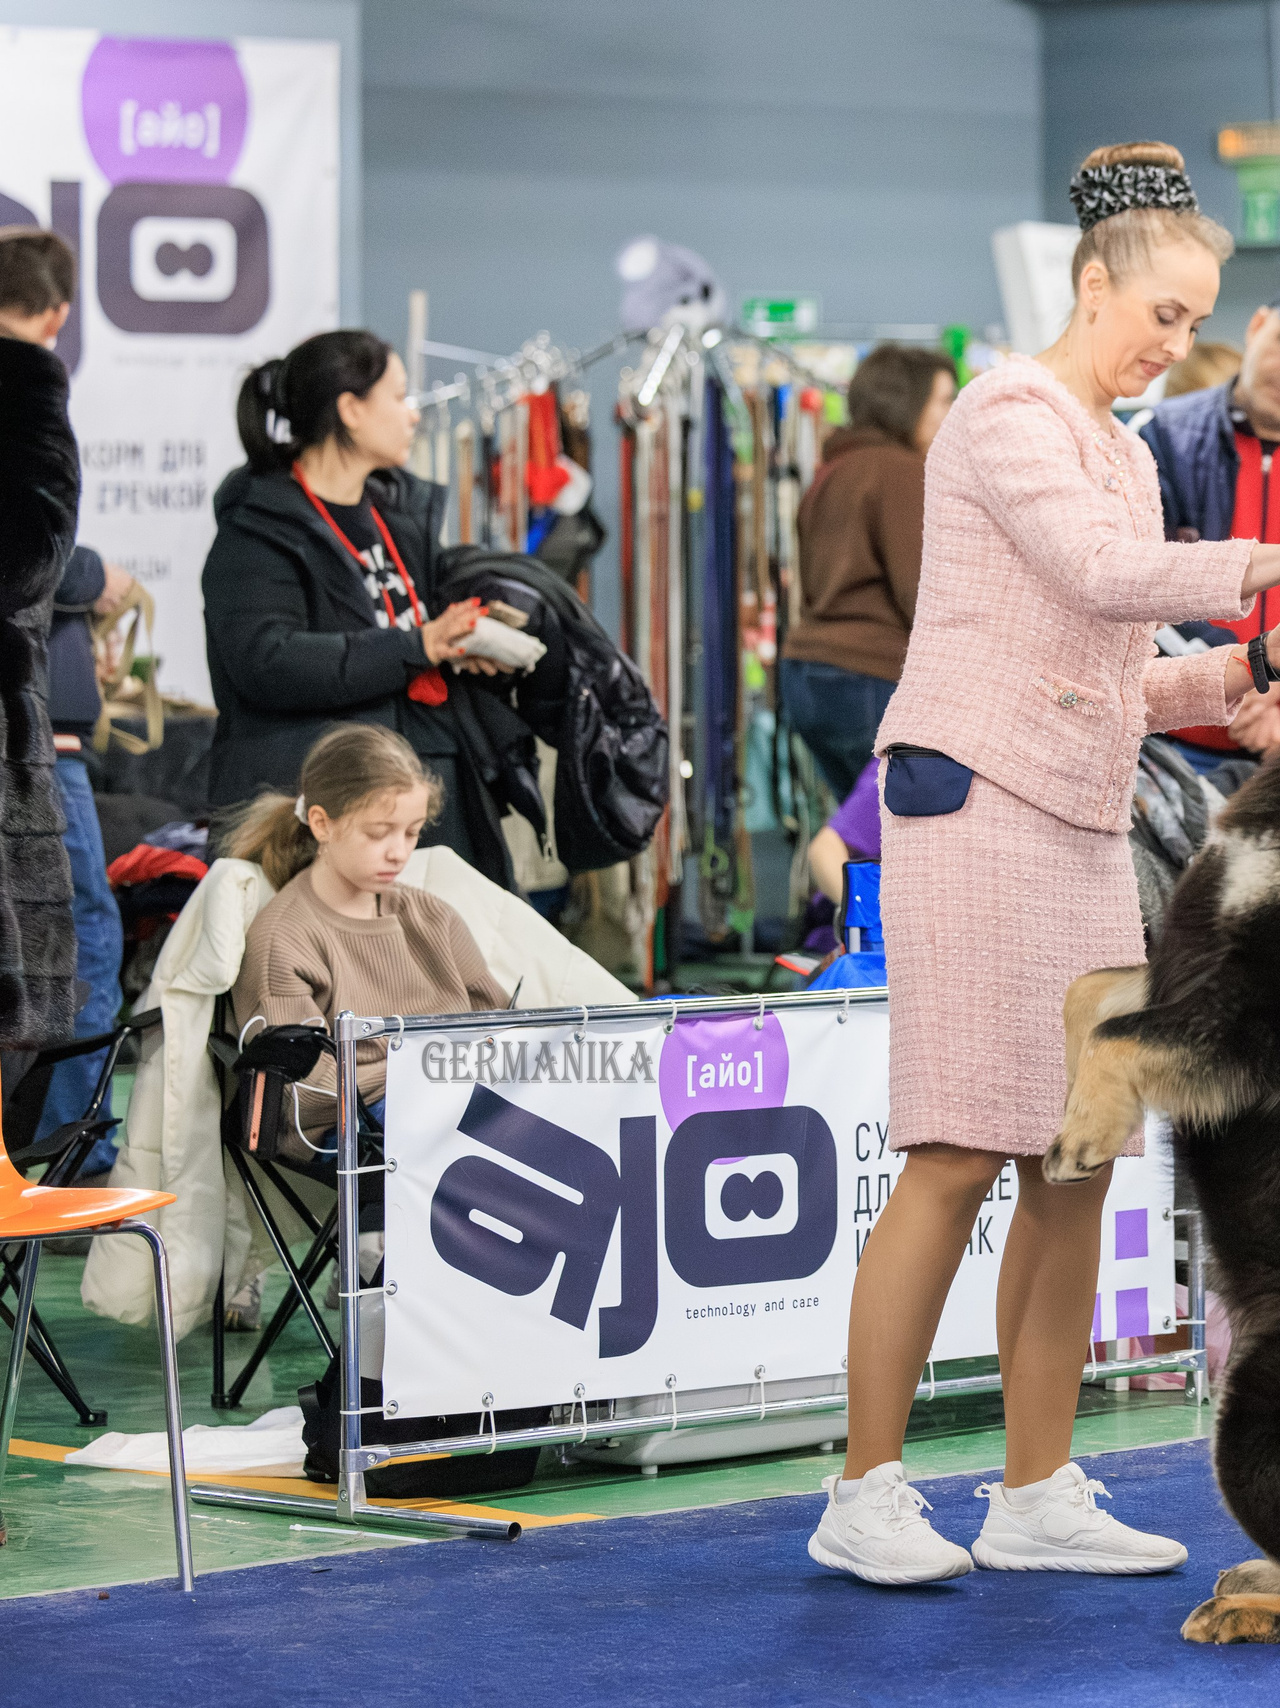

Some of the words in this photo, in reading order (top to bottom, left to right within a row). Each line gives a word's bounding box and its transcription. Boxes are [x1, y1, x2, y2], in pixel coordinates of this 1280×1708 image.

[685, 1302, 757, 1320] technology
[764, 1297, 785, 1312] and
[792, 1296, 819, 1309] care
